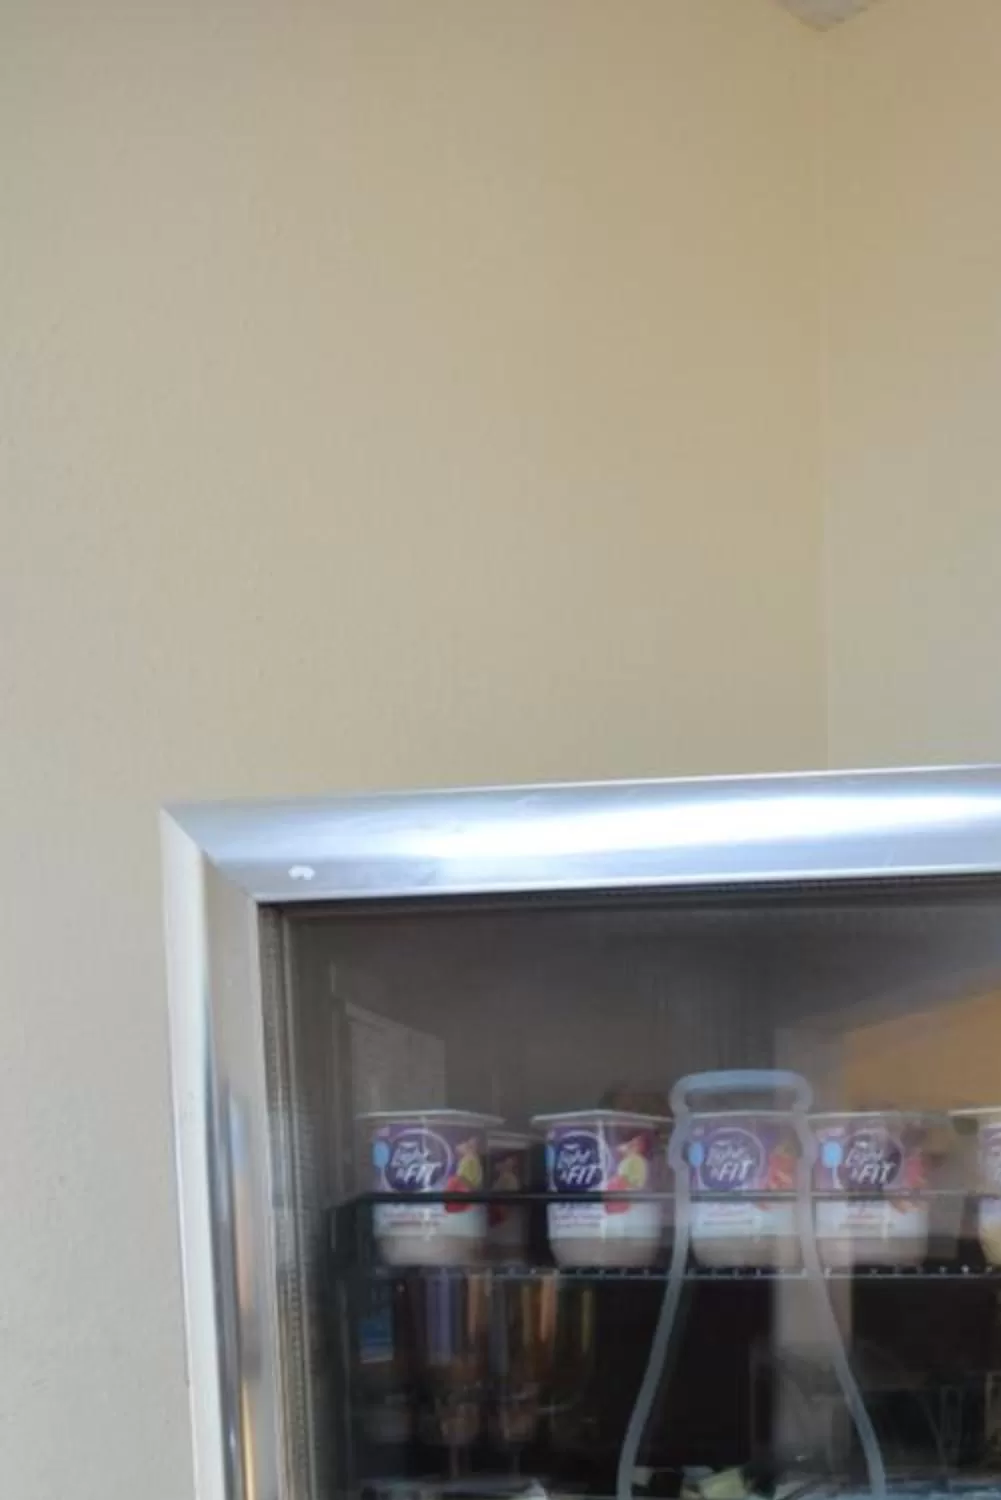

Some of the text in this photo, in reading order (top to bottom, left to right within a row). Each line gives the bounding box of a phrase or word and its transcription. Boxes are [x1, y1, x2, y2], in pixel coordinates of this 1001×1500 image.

[565, 1164, 601, 1185] FIT
[718, 1159, 754, 1183] FIT
[858, 1162, 897, 1185] FIT
